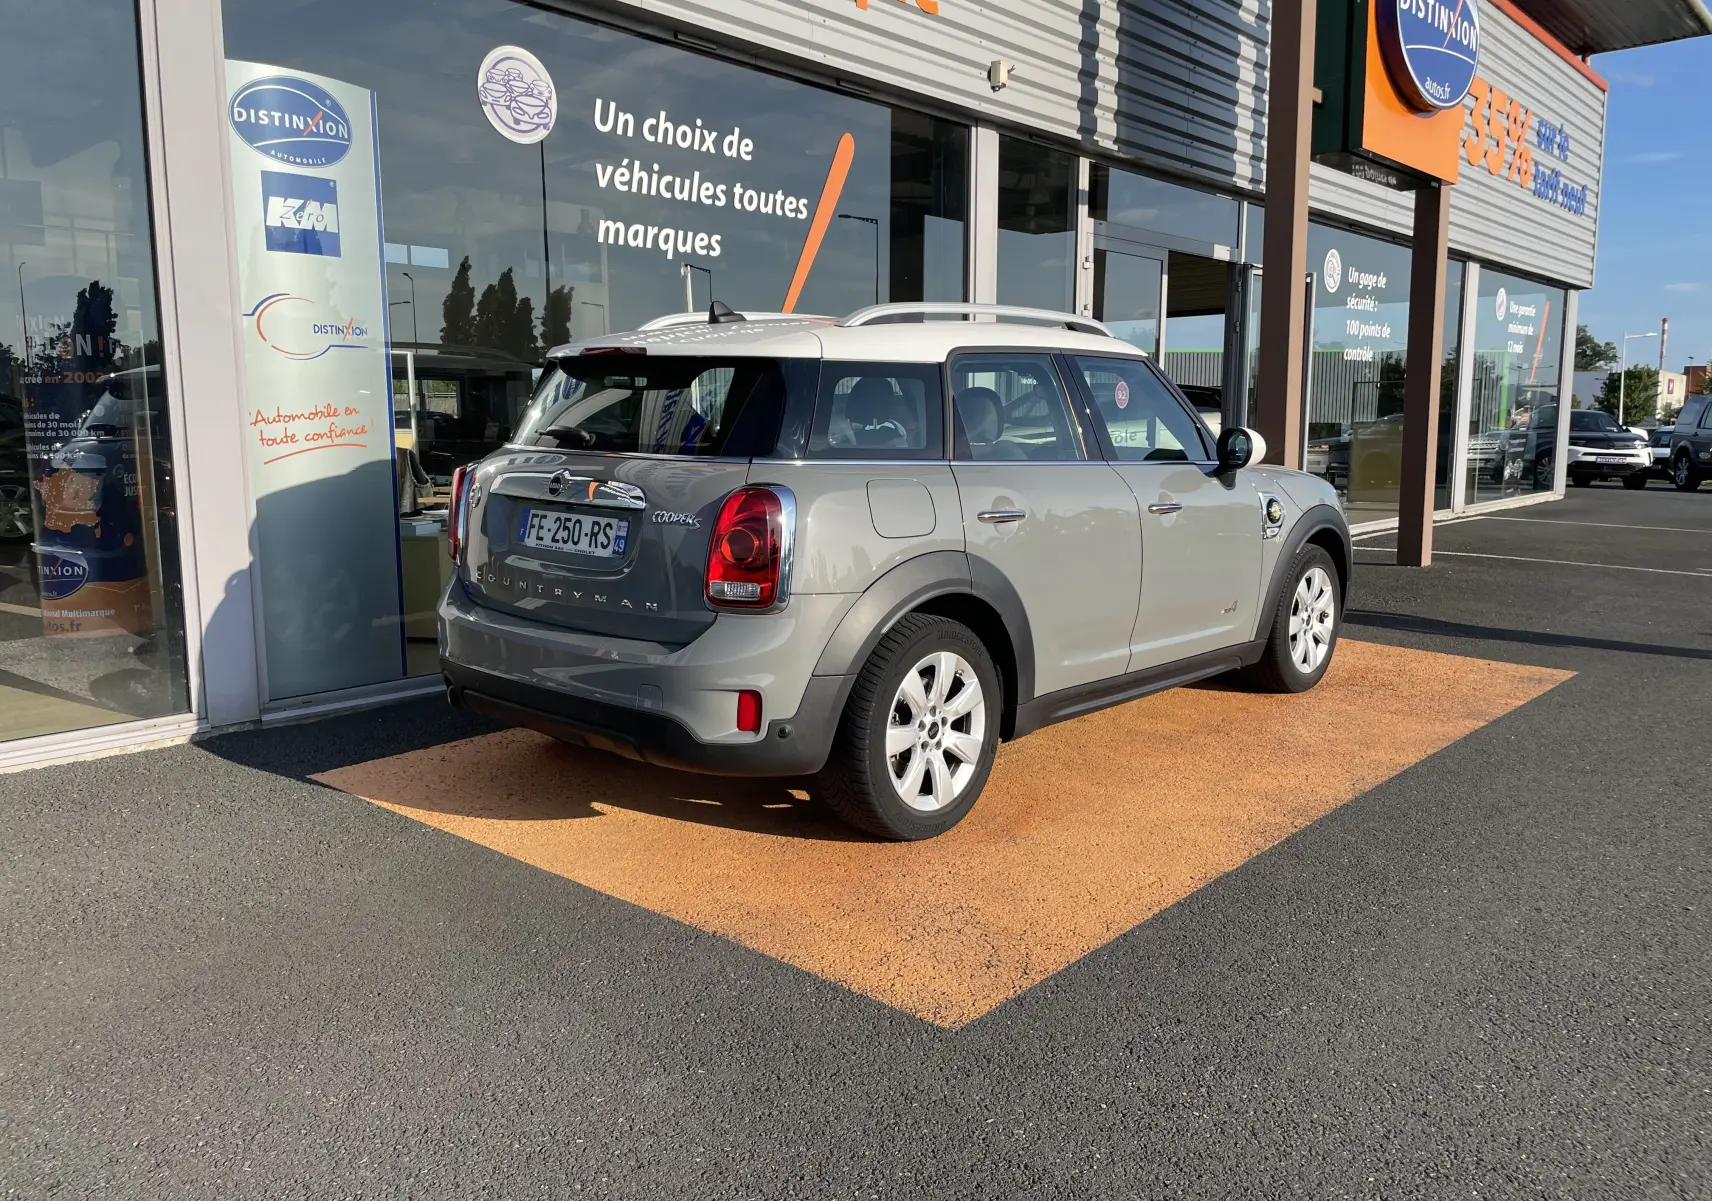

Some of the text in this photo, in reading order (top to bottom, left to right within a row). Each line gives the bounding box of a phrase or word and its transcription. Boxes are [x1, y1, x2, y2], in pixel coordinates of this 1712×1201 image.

[1425, 77, 1450, 100] autos.fr
[234, 106, 349, 139] DISTINXION
[593, 98, 754, 162] Un choix de
[1537, 120, 1557, 156] sur
[270, 149, 327, 165] AUTOMOBILE
[595, 157, 809, 220] véhicules toutes
[1534, 161, 1588, 216] tarif neuf
[598, 218, 721, 260] marques
[1348, 267, 1387, 290] Un gage de
[313, 319, 368, 340] DISTINXION
[1346, 319, 1391, 339] 100 points de
[1344, 346, 1373, 361] contrôle
[44, 376, 59, 384] en
[48, 411, 60, 419] de
[250, 403, 360, 426] Automobile en
[46, 429, 56, 437] de
[90, 429, 105, 437] km
[259, 427, 299, 447] toute
[304, 422, 368, 443] confiance
[613, 539, 625, 552] 49
[476, 571, 658, 612] COUNTRYMAN
[61, 608, 115, 619] Multimarque
